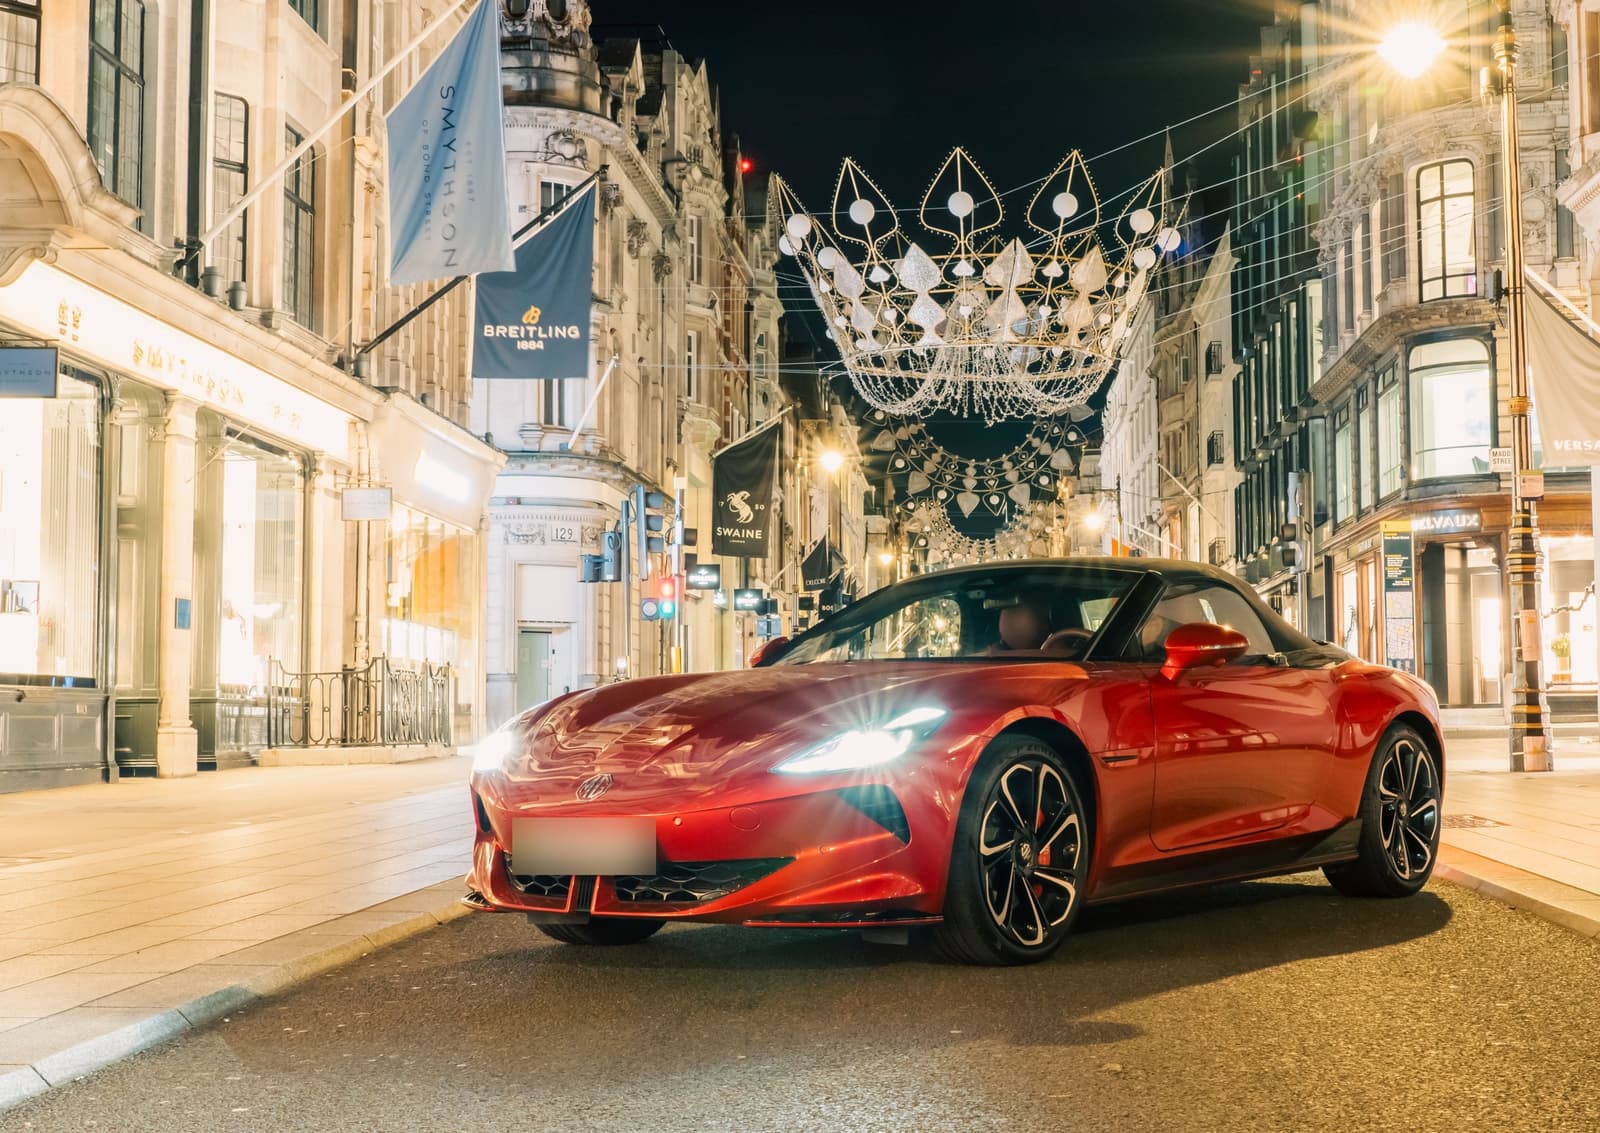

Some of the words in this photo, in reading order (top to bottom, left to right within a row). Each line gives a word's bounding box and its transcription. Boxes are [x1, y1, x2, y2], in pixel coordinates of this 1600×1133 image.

[422, 144, 431, 183] BOND
[440, 85, 458, 268] SMYTHSON
[483, 324, 580, 338] BREITLING
[517, 340, 544, 350] 1884
[555, 527, 573, 540] 129
[716, 526, 763, 539] SWAINE
